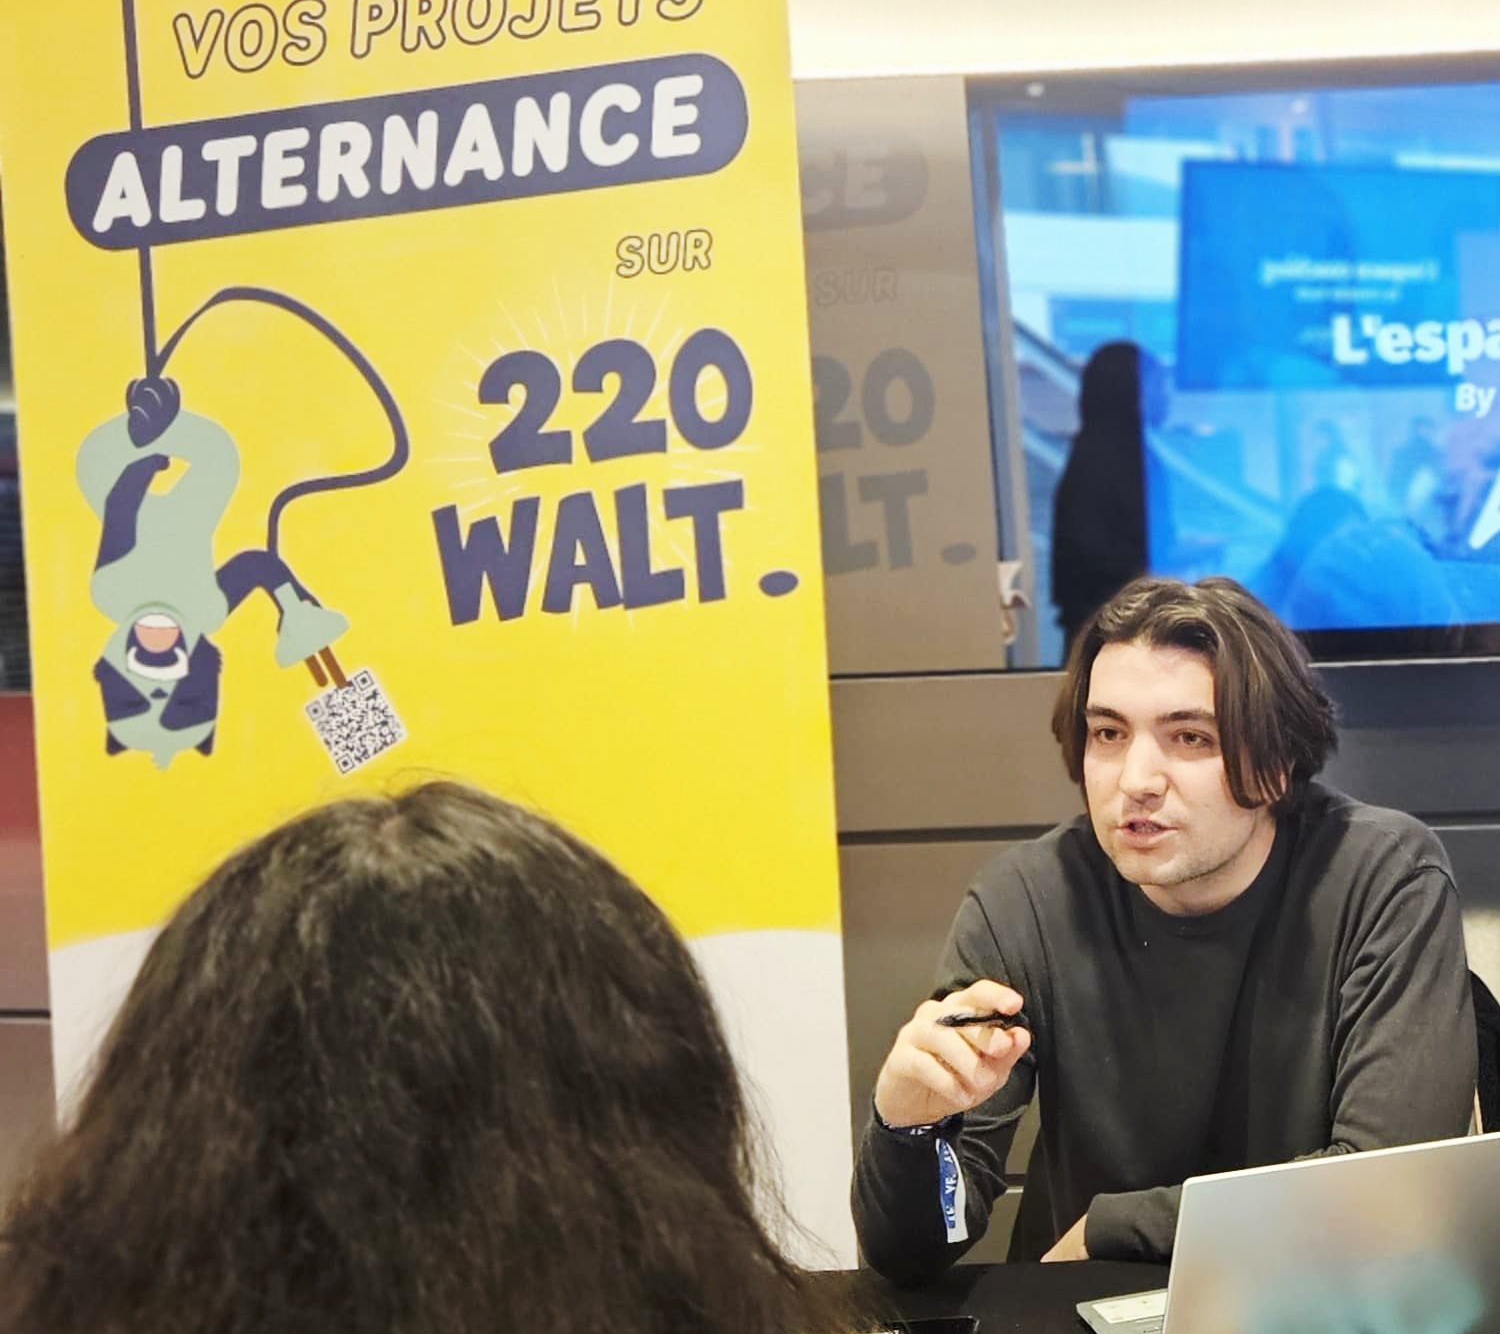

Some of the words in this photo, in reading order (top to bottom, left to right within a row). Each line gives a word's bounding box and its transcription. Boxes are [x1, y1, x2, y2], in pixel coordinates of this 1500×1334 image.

[172, 0, 328, 79] VOS
[91, 73, 705, 234] ALTERNANCE
[616, 228, 713, 278] SUR
[478, 327, 754, 474] 220
[1455, 383, 1496, 419] By
